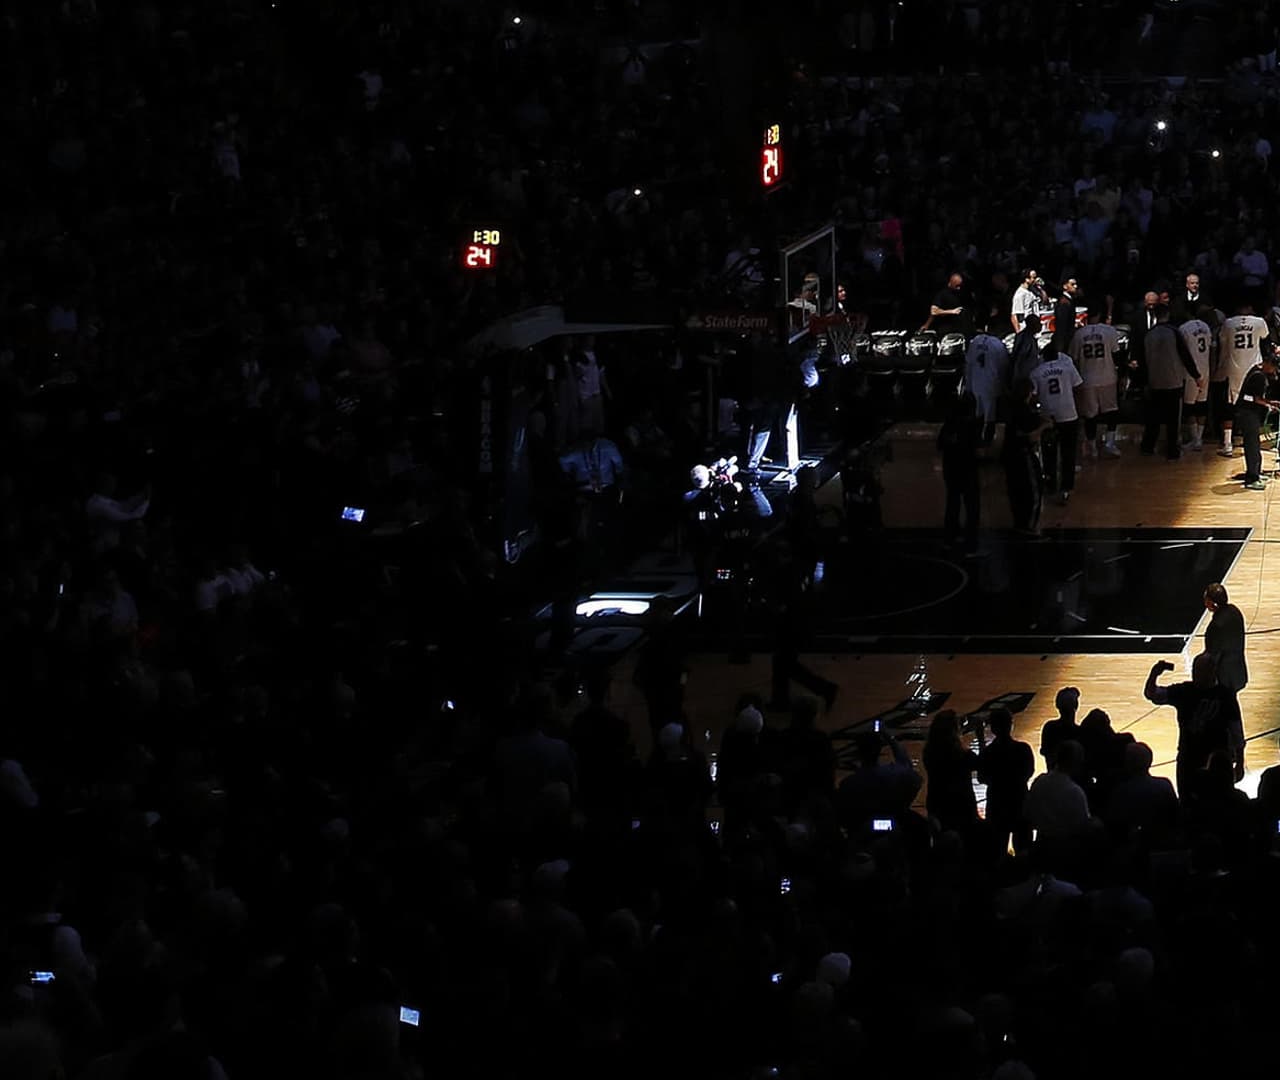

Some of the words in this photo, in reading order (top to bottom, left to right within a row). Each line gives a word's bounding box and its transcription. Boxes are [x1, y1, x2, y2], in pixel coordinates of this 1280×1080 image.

[763, 147, 779, 185] 24
[473, 229, 500, 246] 1:30
[466, 246, 491, 266] 24
[1198, 337, 1207, 352] 3
[1234, 333, 1255, 349] 21
[1083, 343, 1105, 358] 22
[1048, 378, 1060, 394] 2
